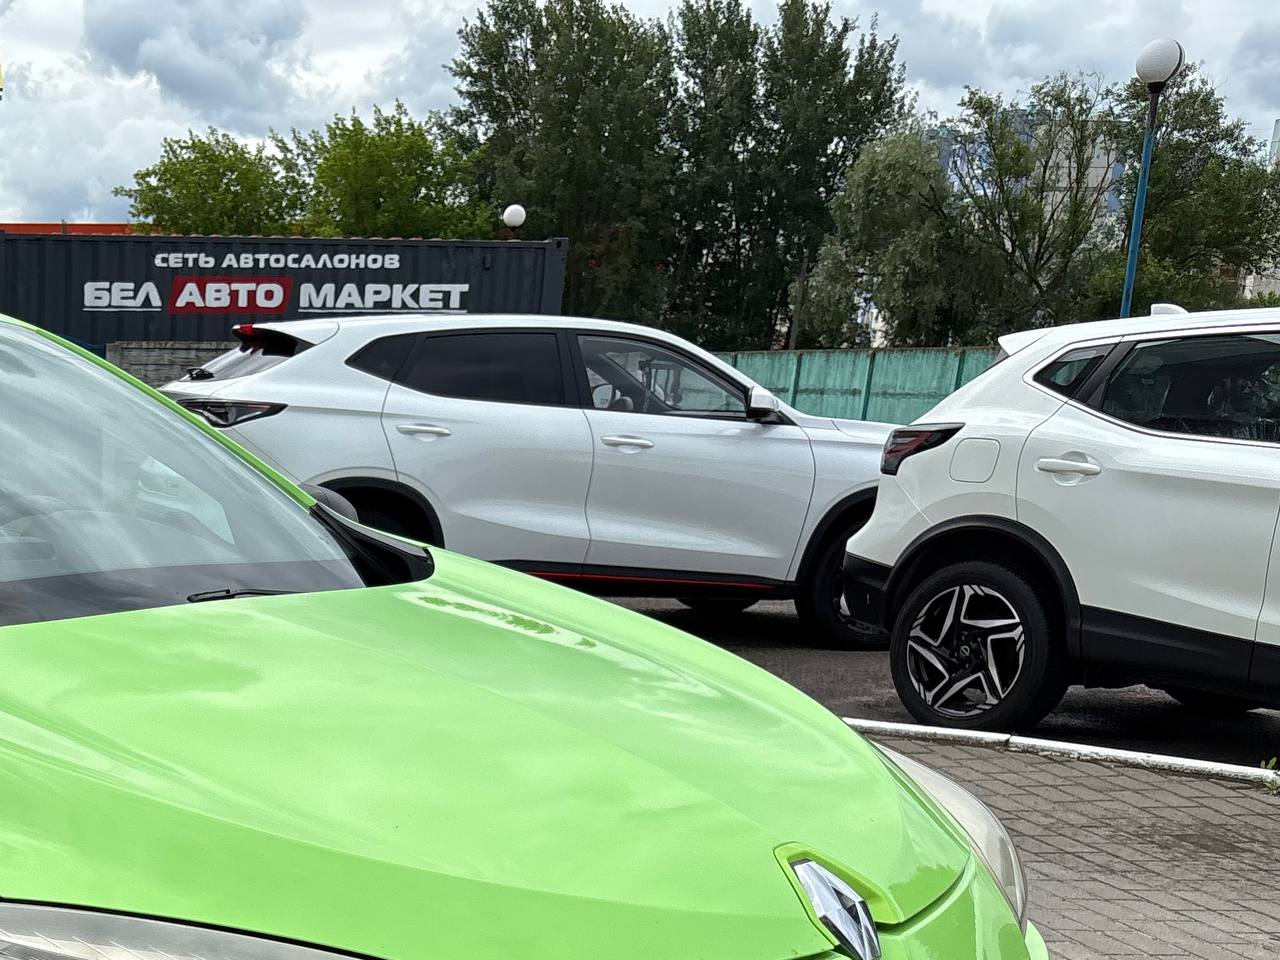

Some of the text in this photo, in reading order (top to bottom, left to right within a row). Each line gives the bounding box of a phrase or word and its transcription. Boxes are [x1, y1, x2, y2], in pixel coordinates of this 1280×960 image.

[154, 253, 401, 269] СЕТЬ АВТОСАЛОНОВ
[83, 281, 470, 309] БЕЛ АВТО МАРКЕТ
